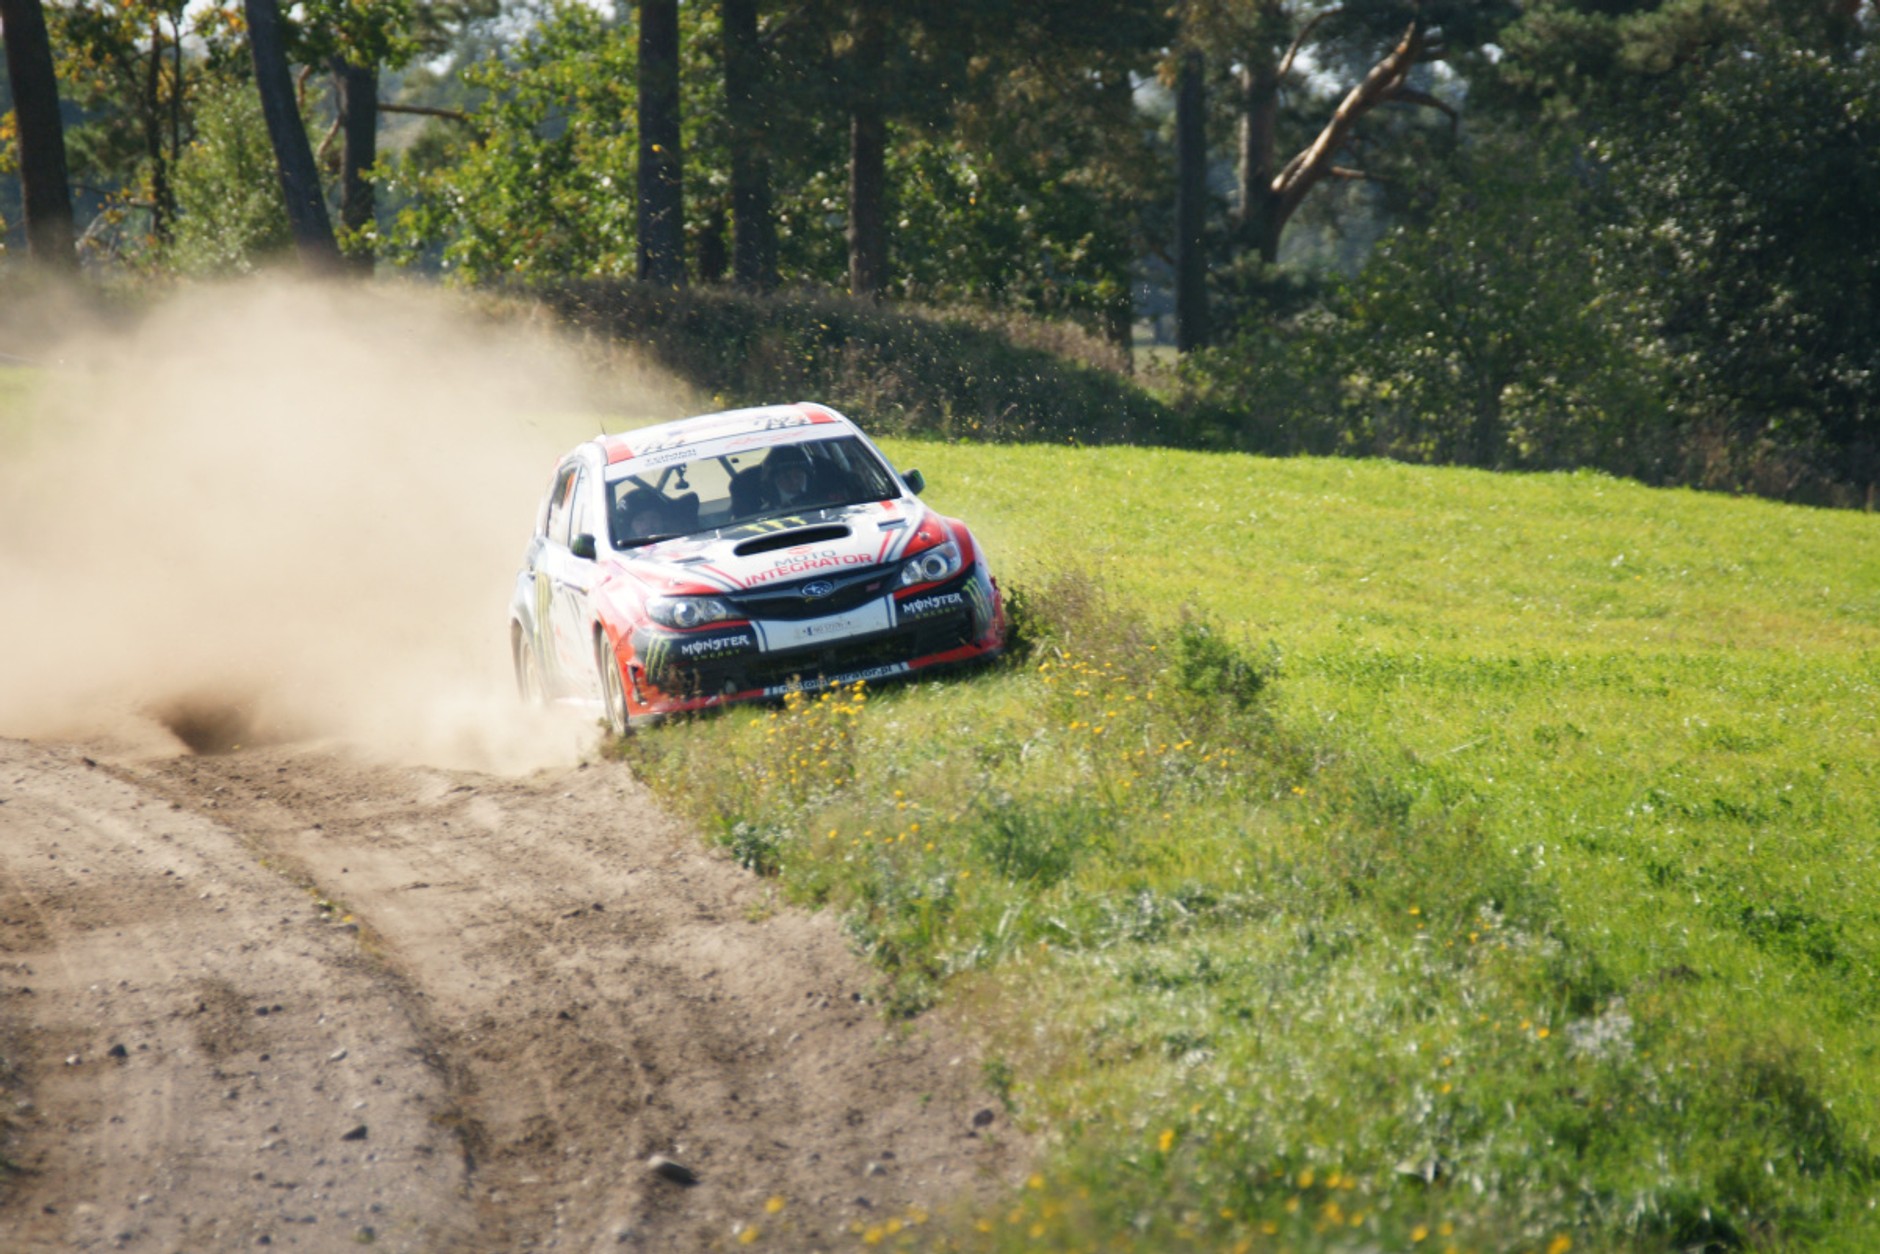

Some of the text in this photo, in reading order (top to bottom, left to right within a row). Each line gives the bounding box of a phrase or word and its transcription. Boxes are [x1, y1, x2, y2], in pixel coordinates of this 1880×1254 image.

[774, 550, 836, 567] MOTO
[745, 553, 873, 586] INTEGRATOR
[902, 593, 963, 614] MONSTER
[681, 634, 750, 655] MONSTER
